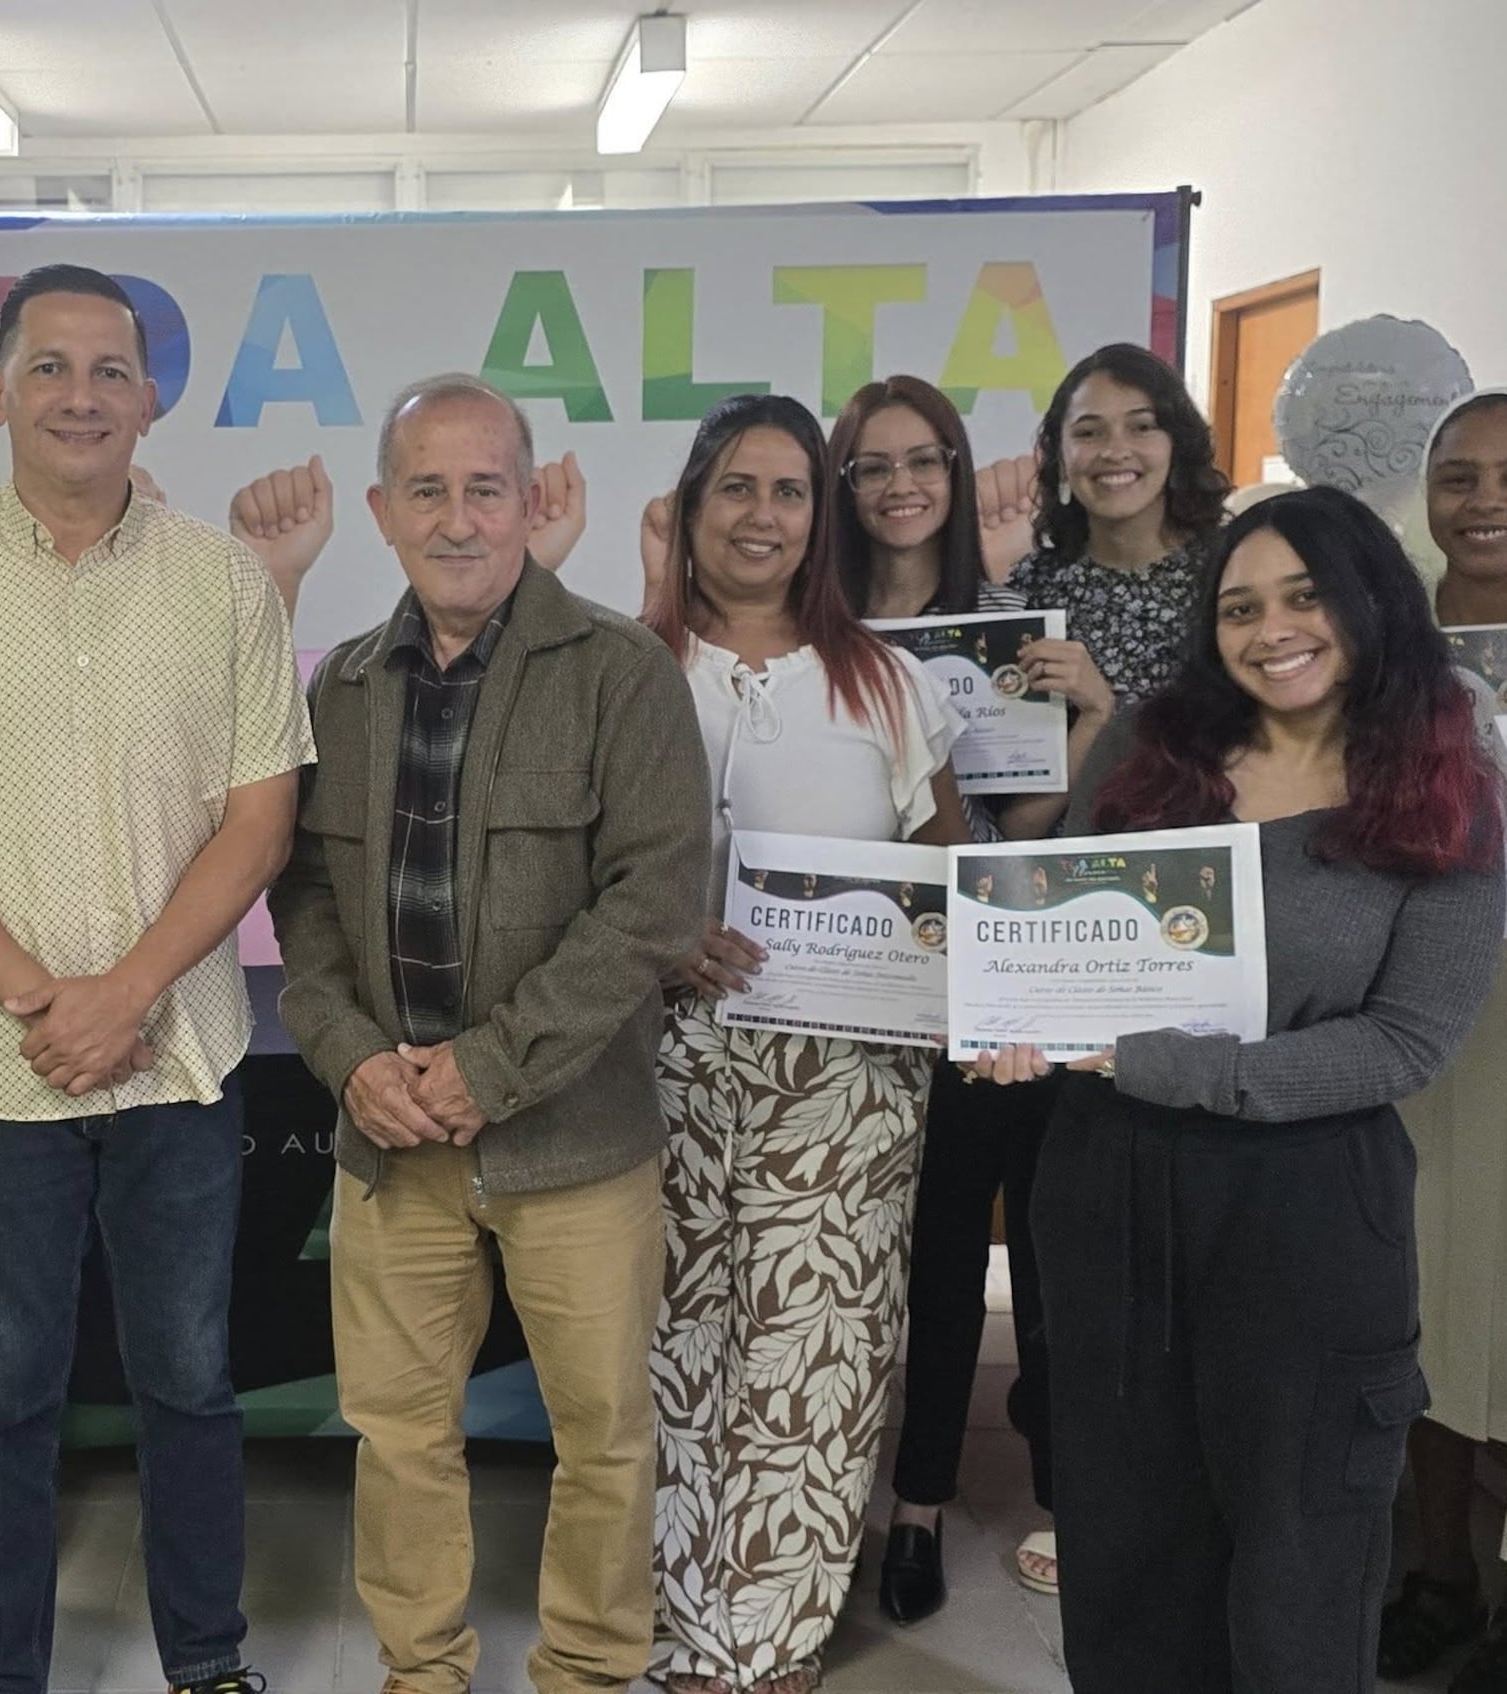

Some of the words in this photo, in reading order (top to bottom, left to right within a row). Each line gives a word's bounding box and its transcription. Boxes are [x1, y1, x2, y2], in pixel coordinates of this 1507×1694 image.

[479, 261, 1068, 423] ALTA
[750, 905, 894, 938] CERTIFICADO
[977, 917, 1139, 944] CERTIFICADO
[765, 938, 802, 956] Sally
[888, 949, 930, 965] Otero
[983, 959, 1079, 975] Alexandra
[1086, 958, 1131, 974] Ortiz
[1137, 957, 1194, 973] Torres
